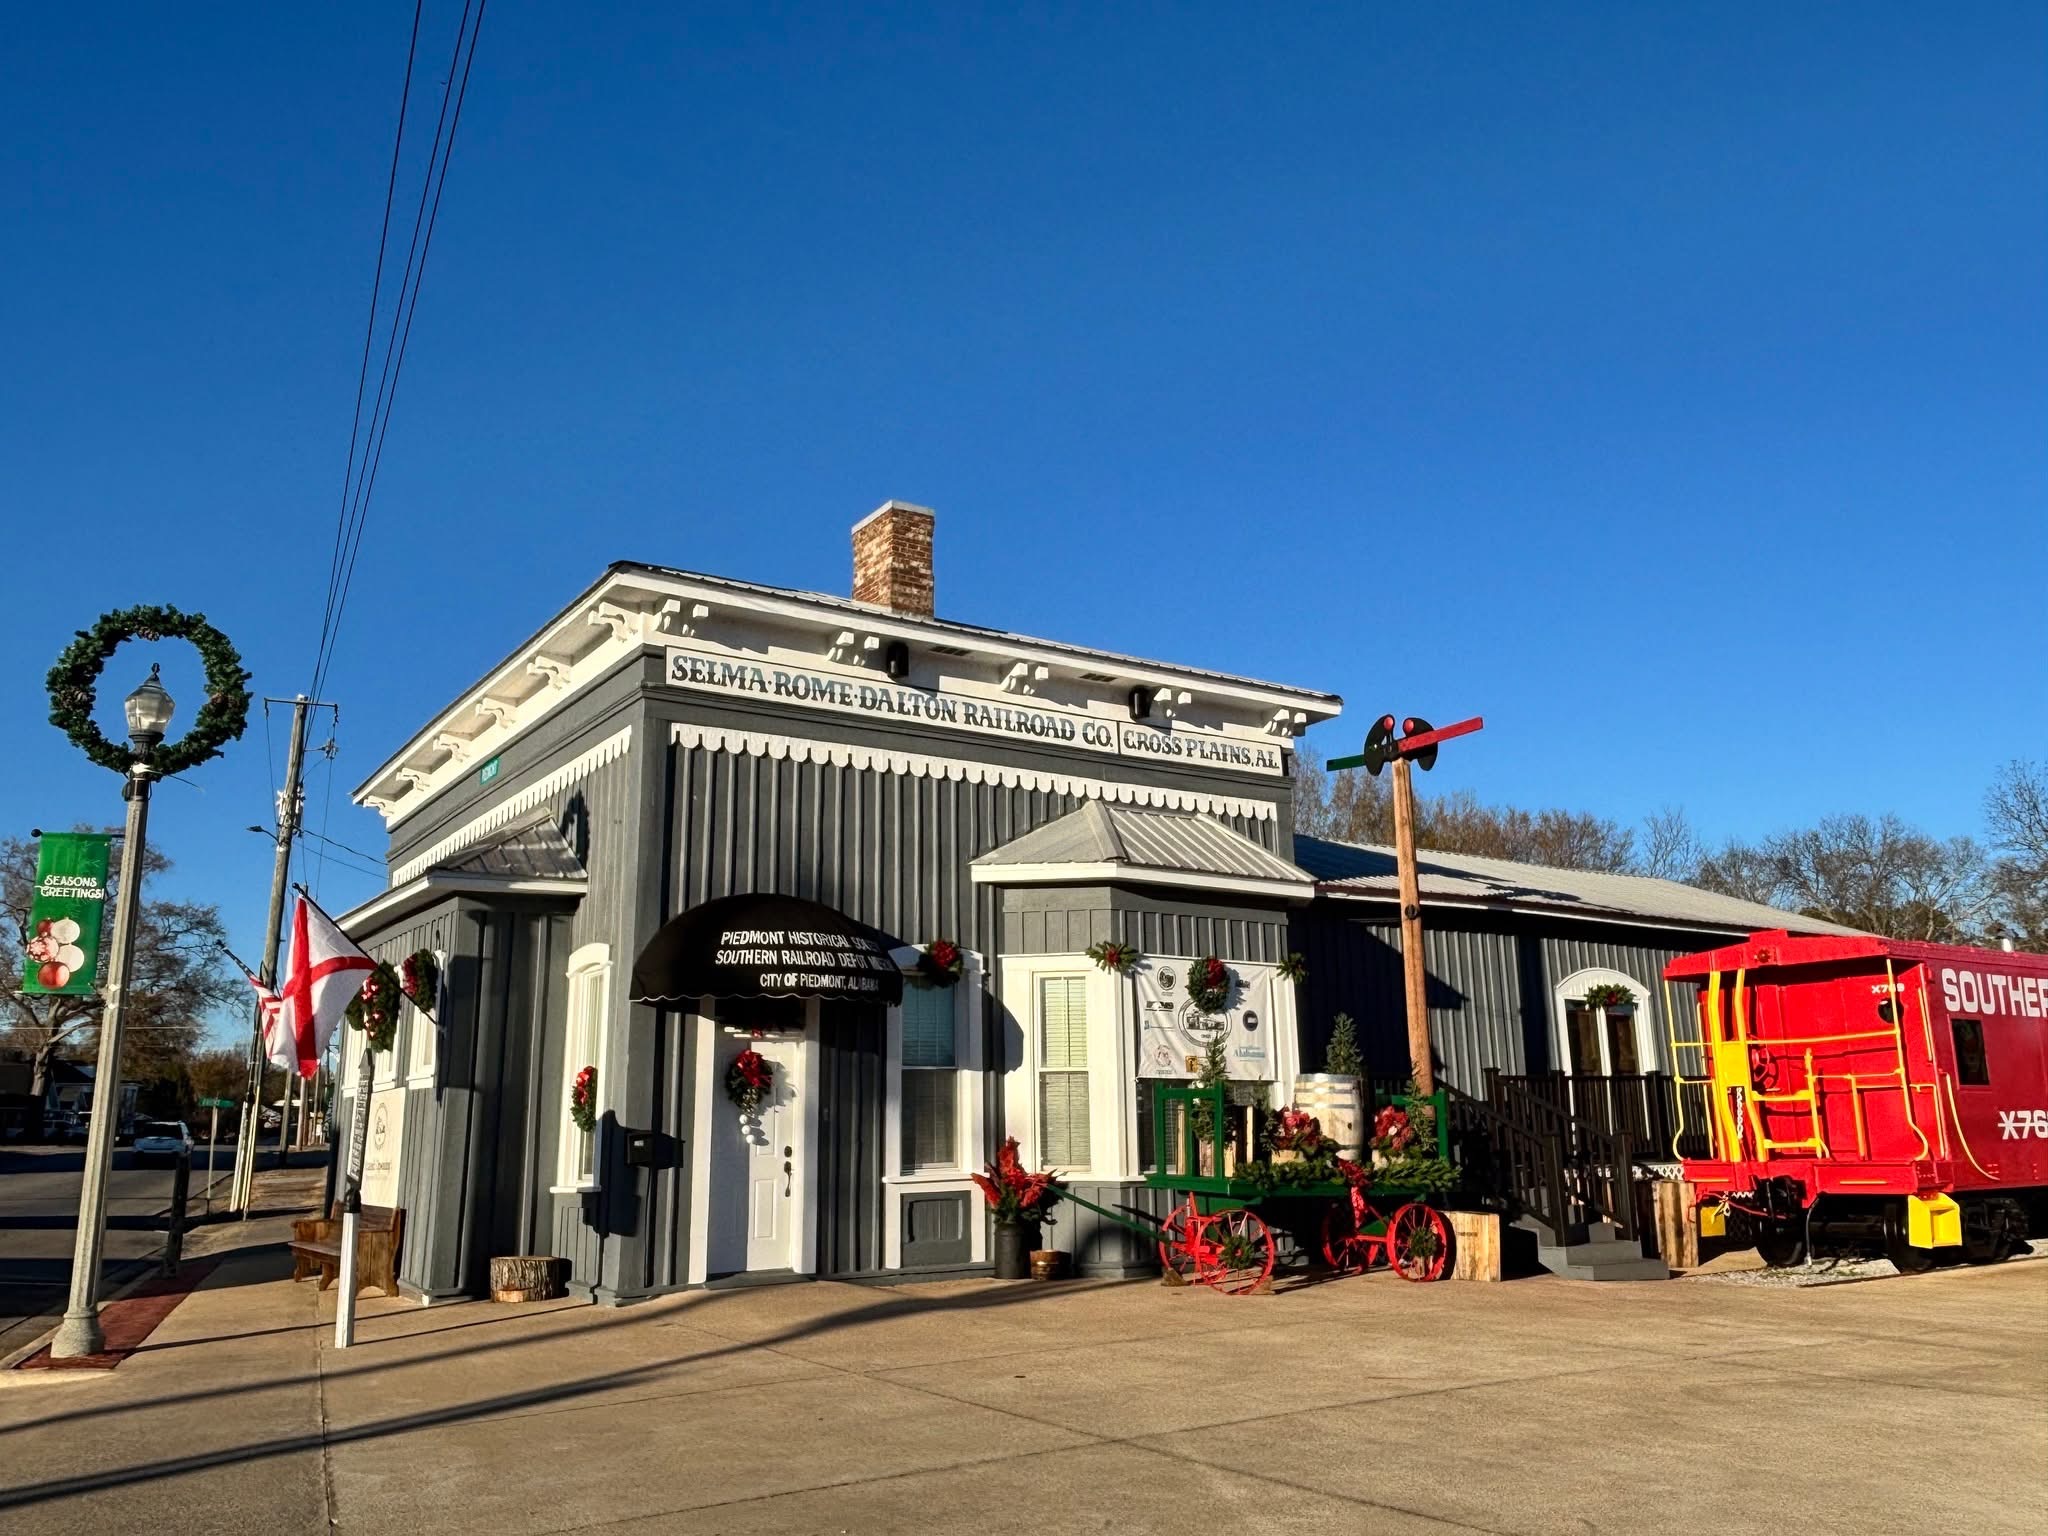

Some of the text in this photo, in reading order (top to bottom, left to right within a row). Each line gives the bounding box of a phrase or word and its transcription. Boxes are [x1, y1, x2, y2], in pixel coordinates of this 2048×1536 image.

[962, 701, 1076, 742] RAILROAD
[1082, 719, 1113, 747] CO.
[1123, 729, 1183, 756] CROSS
[44, 874, 97, 887] SEASONS
[35, 886, 105, 899] GREETINGS!
[720, 931, 785, 945] PIEDMONT
[788, 931, 852, 948] HISTORICAL
[715, 950, 778, 965] SOUTHERN
[782, 950, 836, 966] RAILROAD
[760, 973, 782, 987] CITY
[783, 973, 799, 987] OF
[800, 974, 847, 990] PIEDMONT,
[1998, 1109, 2048, 1140] X76
